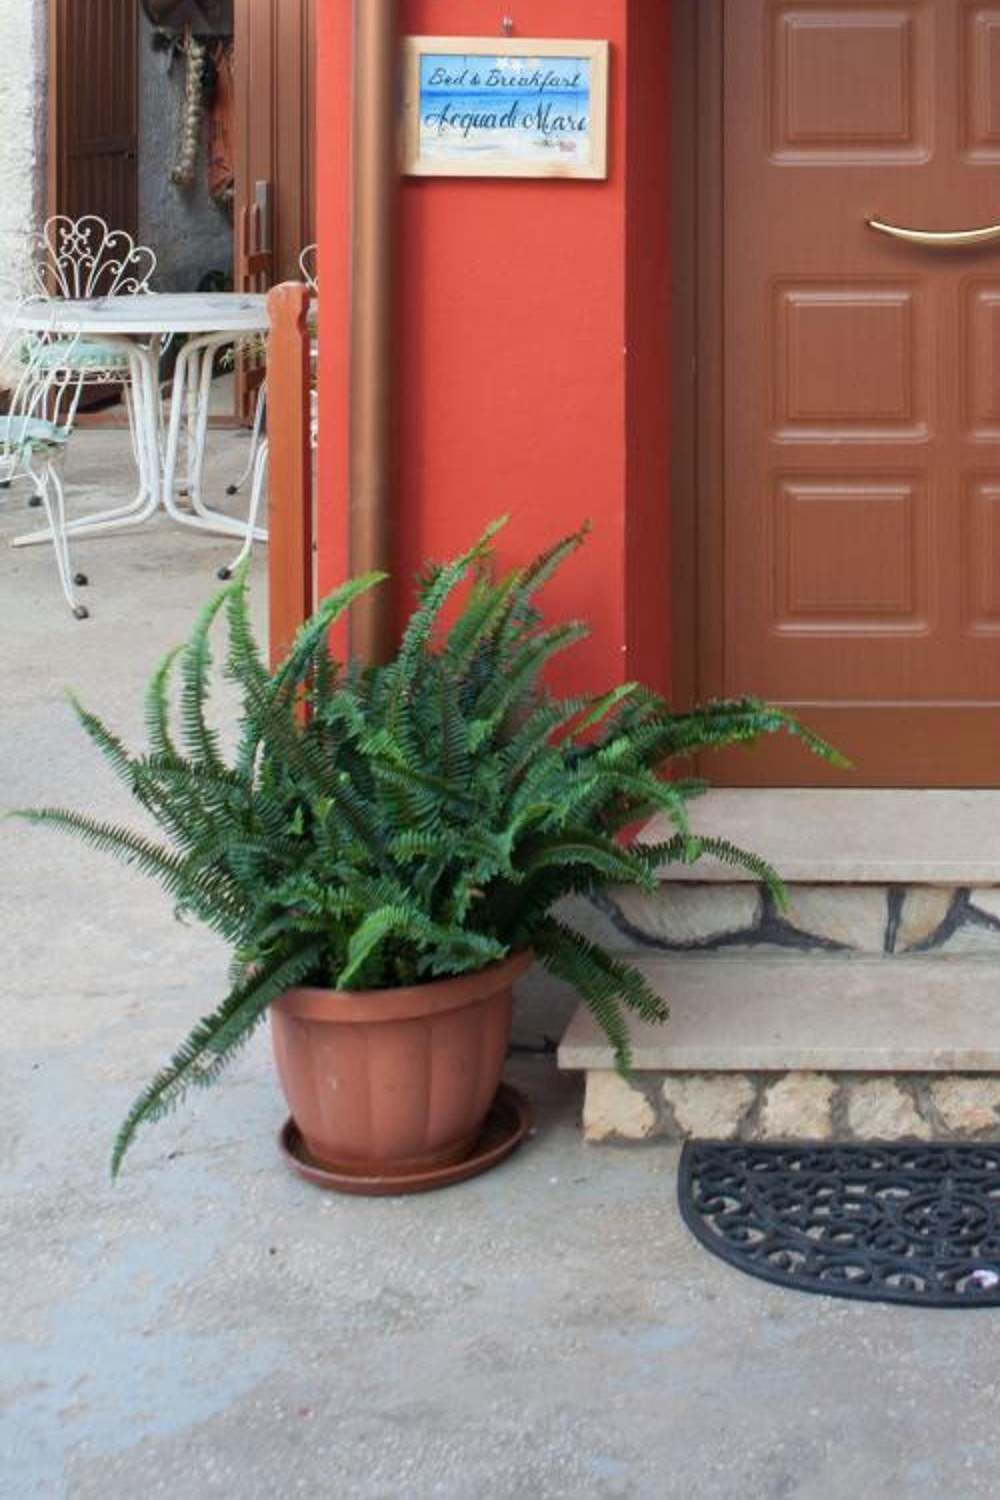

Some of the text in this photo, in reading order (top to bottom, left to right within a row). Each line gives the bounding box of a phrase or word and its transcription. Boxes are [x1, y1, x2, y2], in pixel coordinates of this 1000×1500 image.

[428, 67, 468, 86] Bed
[485, 68, 582, 93] Breakfast
[424, 103, 497, 138] Acqua
[522, 101, 587, 135] Mare
